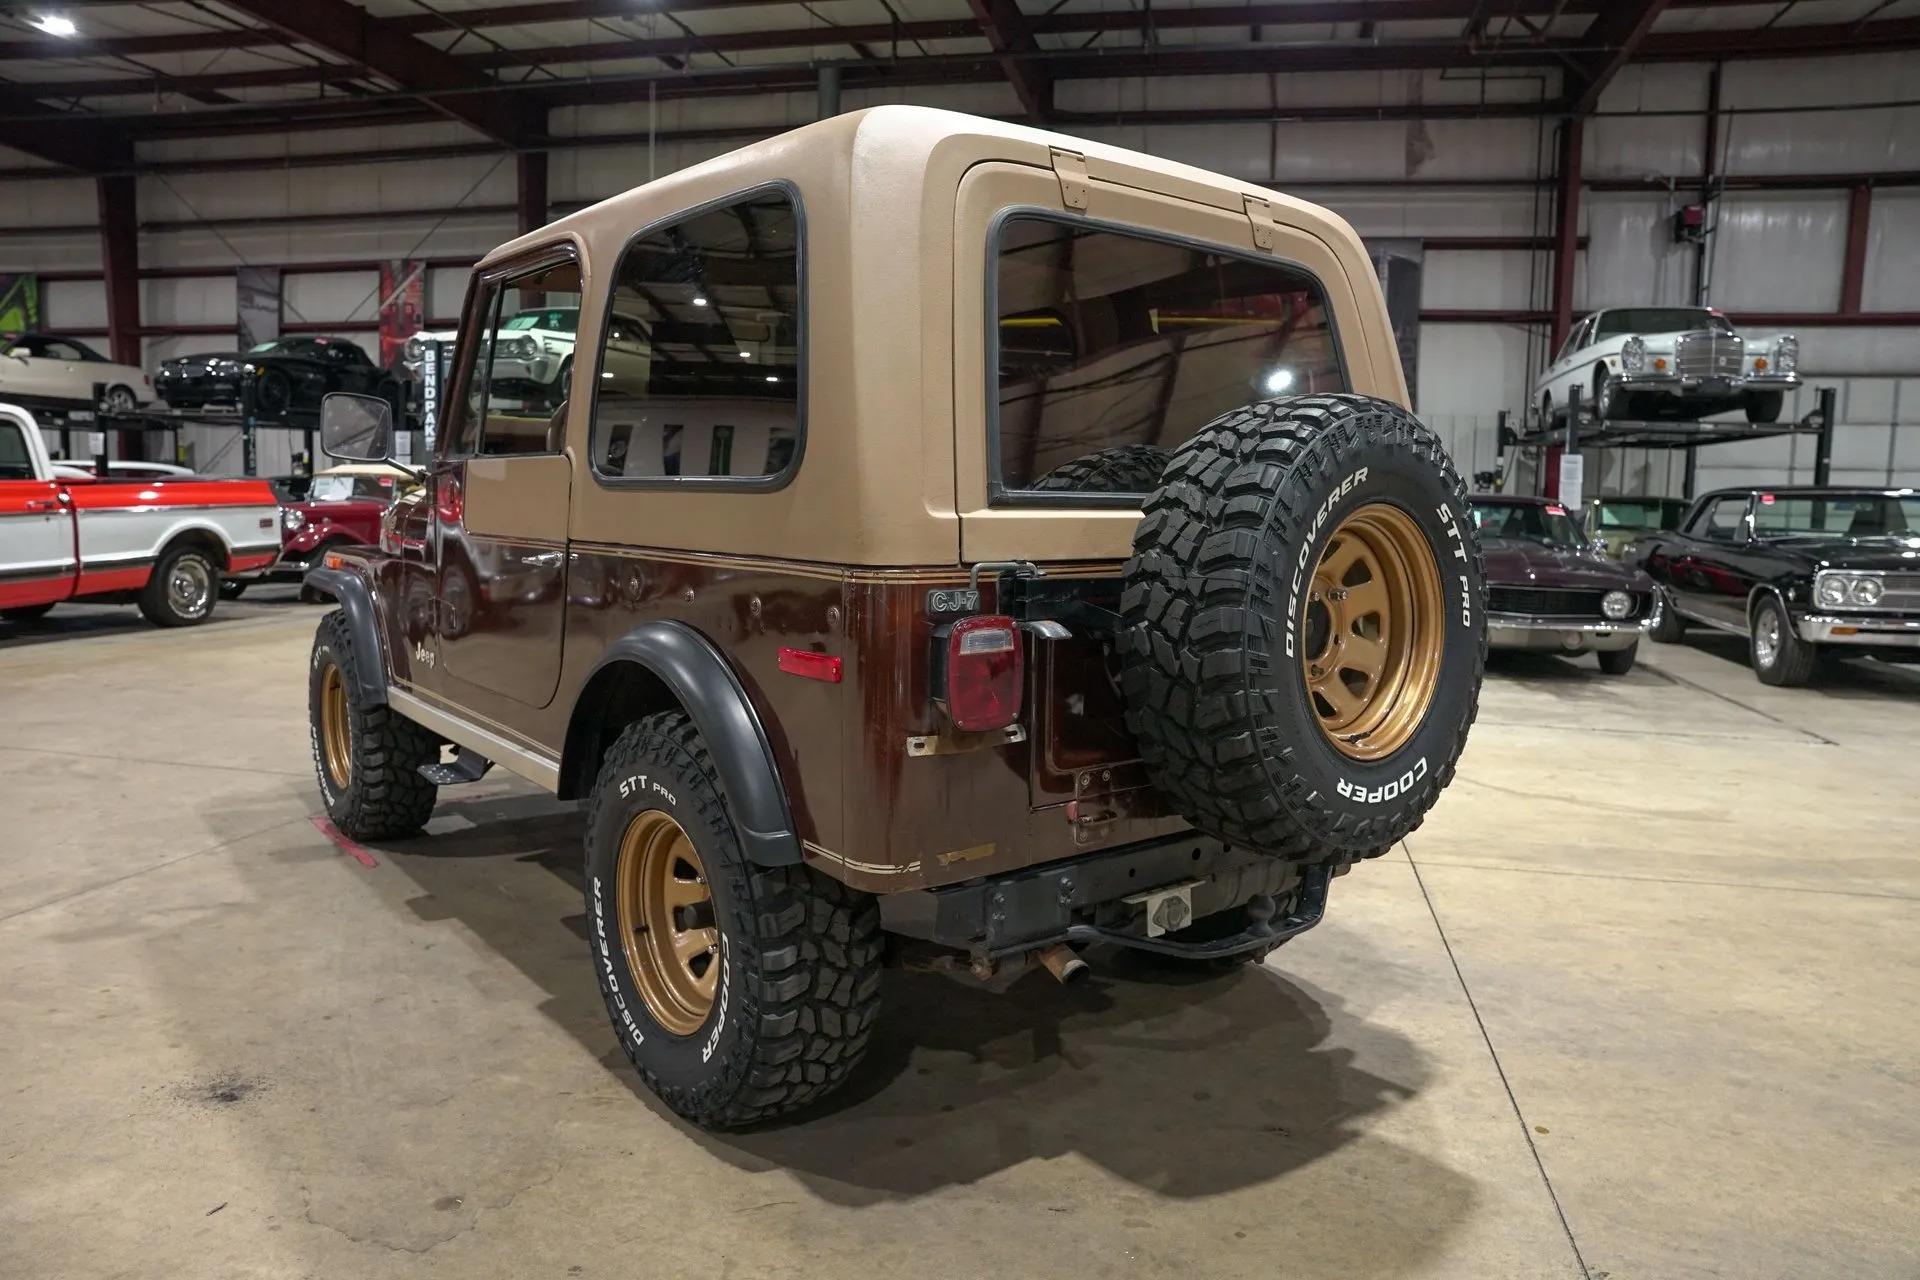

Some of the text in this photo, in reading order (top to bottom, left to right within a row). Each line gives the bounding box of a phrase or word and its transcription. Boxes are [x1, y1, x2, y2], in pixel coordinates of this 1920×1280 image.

[424, 349, 436, 436] BENDPAK
[932, 591, 978, 611] CJ-7
[1286, 466, 1369, 658] DISCOVERER
[1436, 503, 1470, 629] STT PRO
[415, 641, 435, 669] Jeep
[619, 775, 676, 806] STT PRO
[1337, 757, 1427, 804] COOPER
[593, 876, 644, 1046] DISCOVERER
[702, 932, 730, 1063] COOPER
